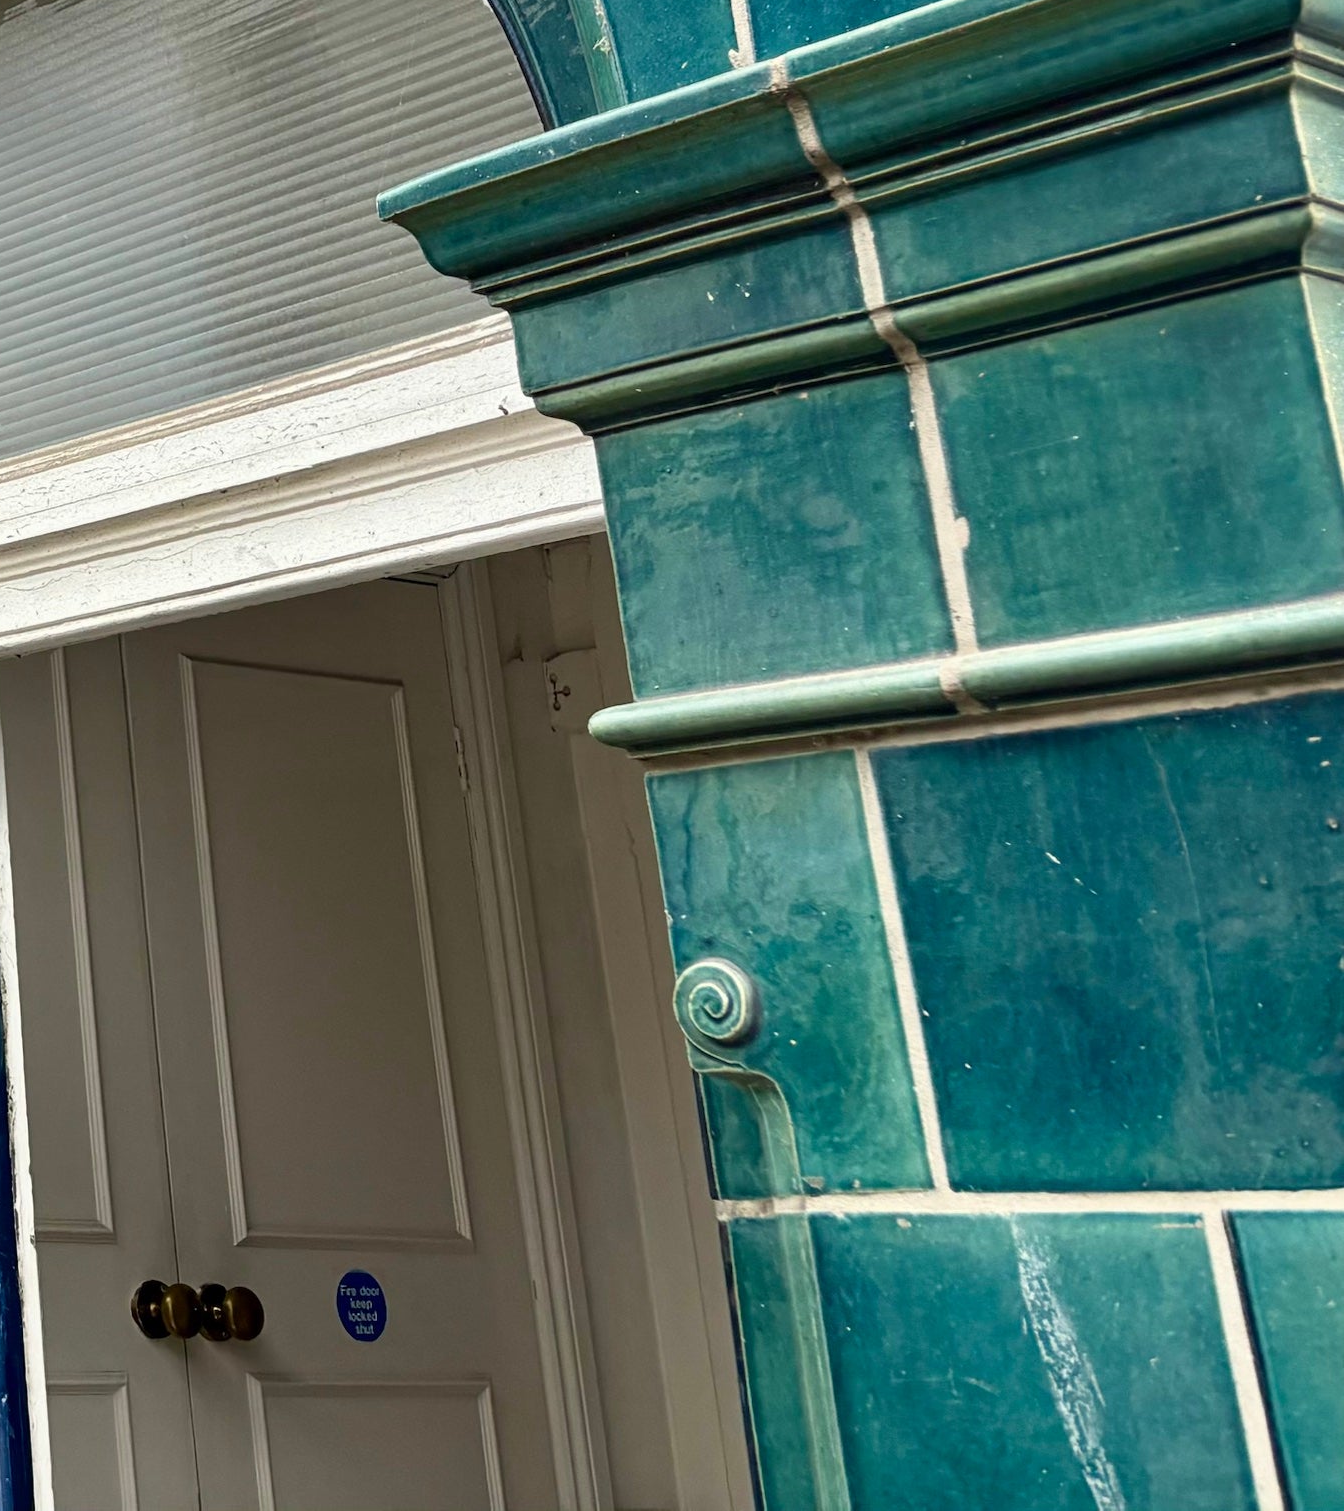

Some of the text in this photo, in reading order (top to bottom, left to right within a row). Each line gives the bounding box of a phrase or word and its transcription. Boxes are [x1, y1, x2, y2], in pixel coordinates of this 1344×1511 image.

[340, 1284, 380, 1296] Fire door
[350, 1298, 373, 1310] keep
[348, 1310, 377, 1322] locked
[355, 1323, 374, 1334] shut
